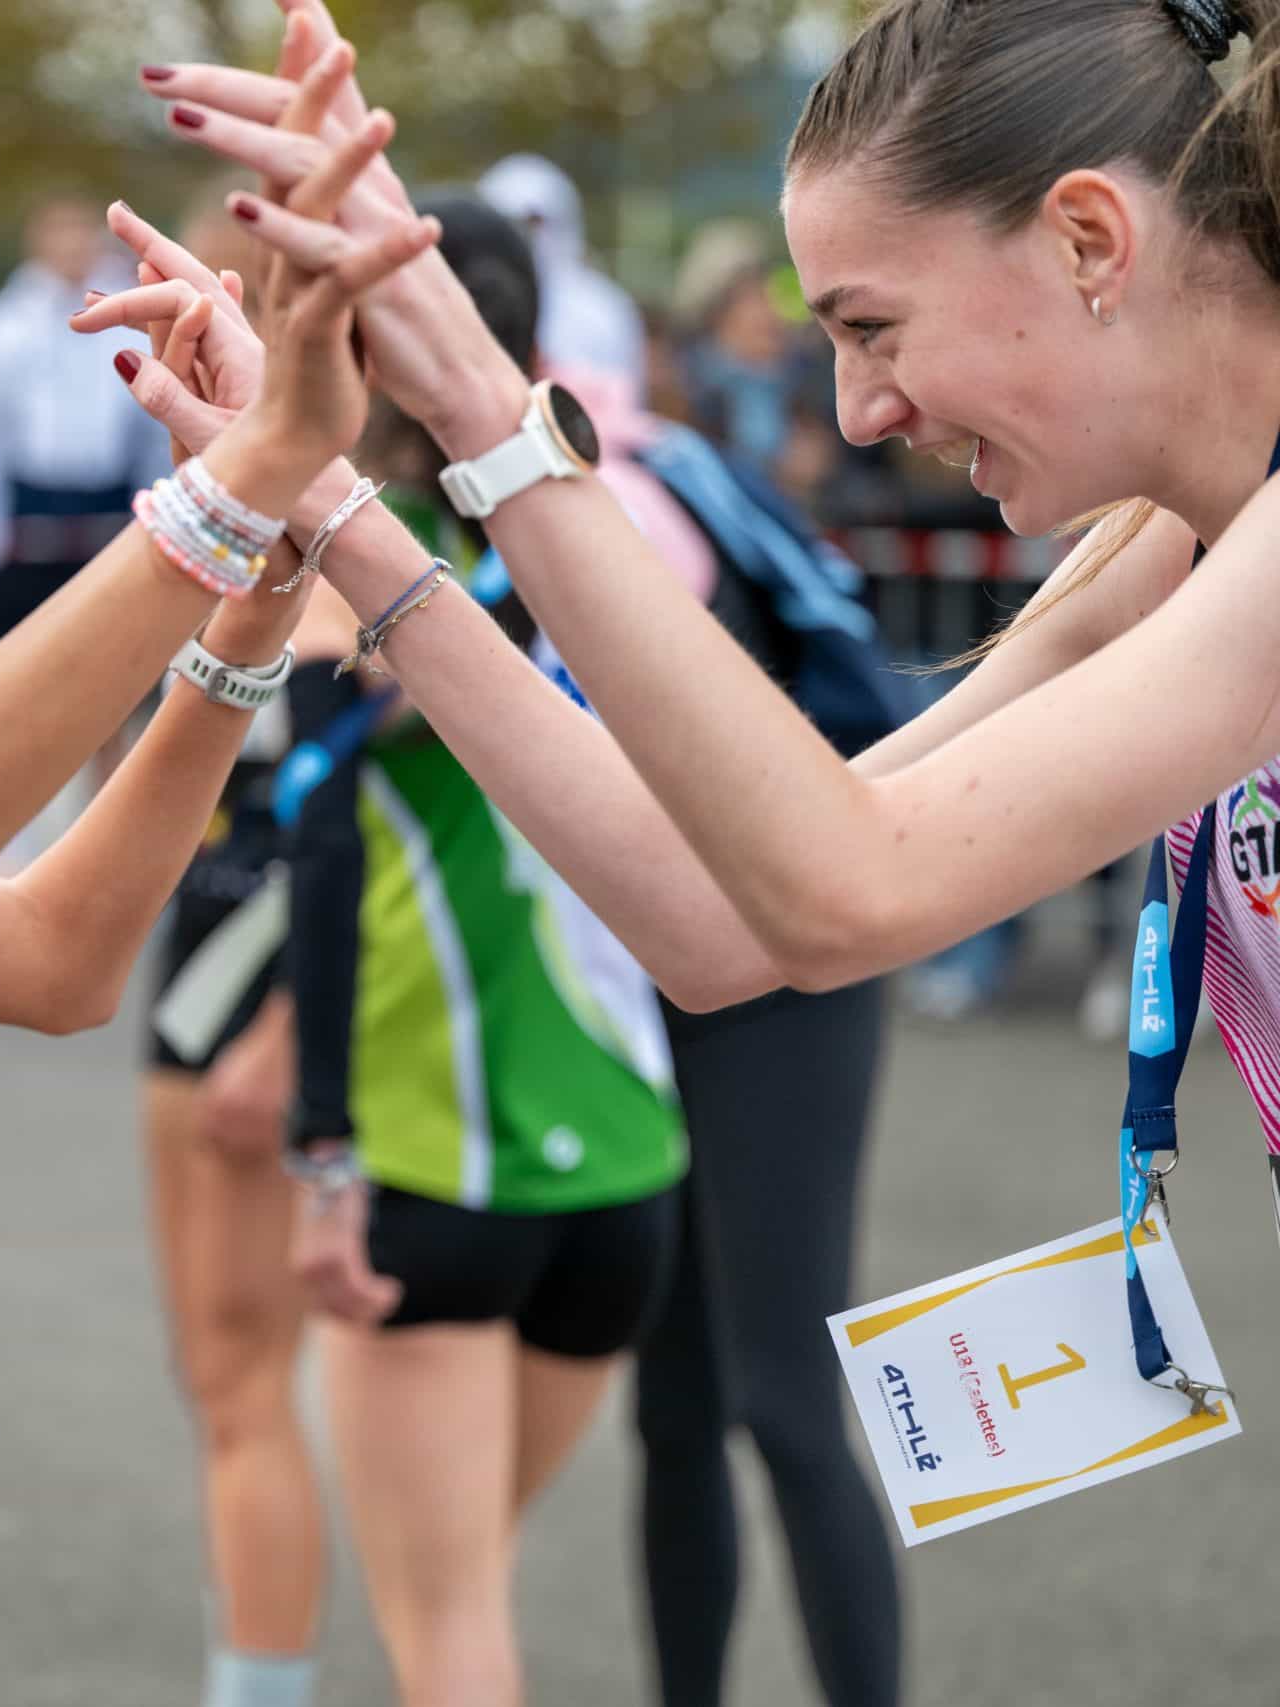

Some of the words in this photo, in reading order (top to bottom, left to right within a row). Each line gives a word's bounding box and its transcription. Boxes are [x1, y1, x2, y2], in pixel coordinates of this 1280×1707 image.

[1140, 925, 1166, 1032] ATHLÉ
[949, 1333, 973, 1368] U18
[998, 1342, 1087, 1410] 1
[882, 1364, 942, 1472] ATHLÉ
